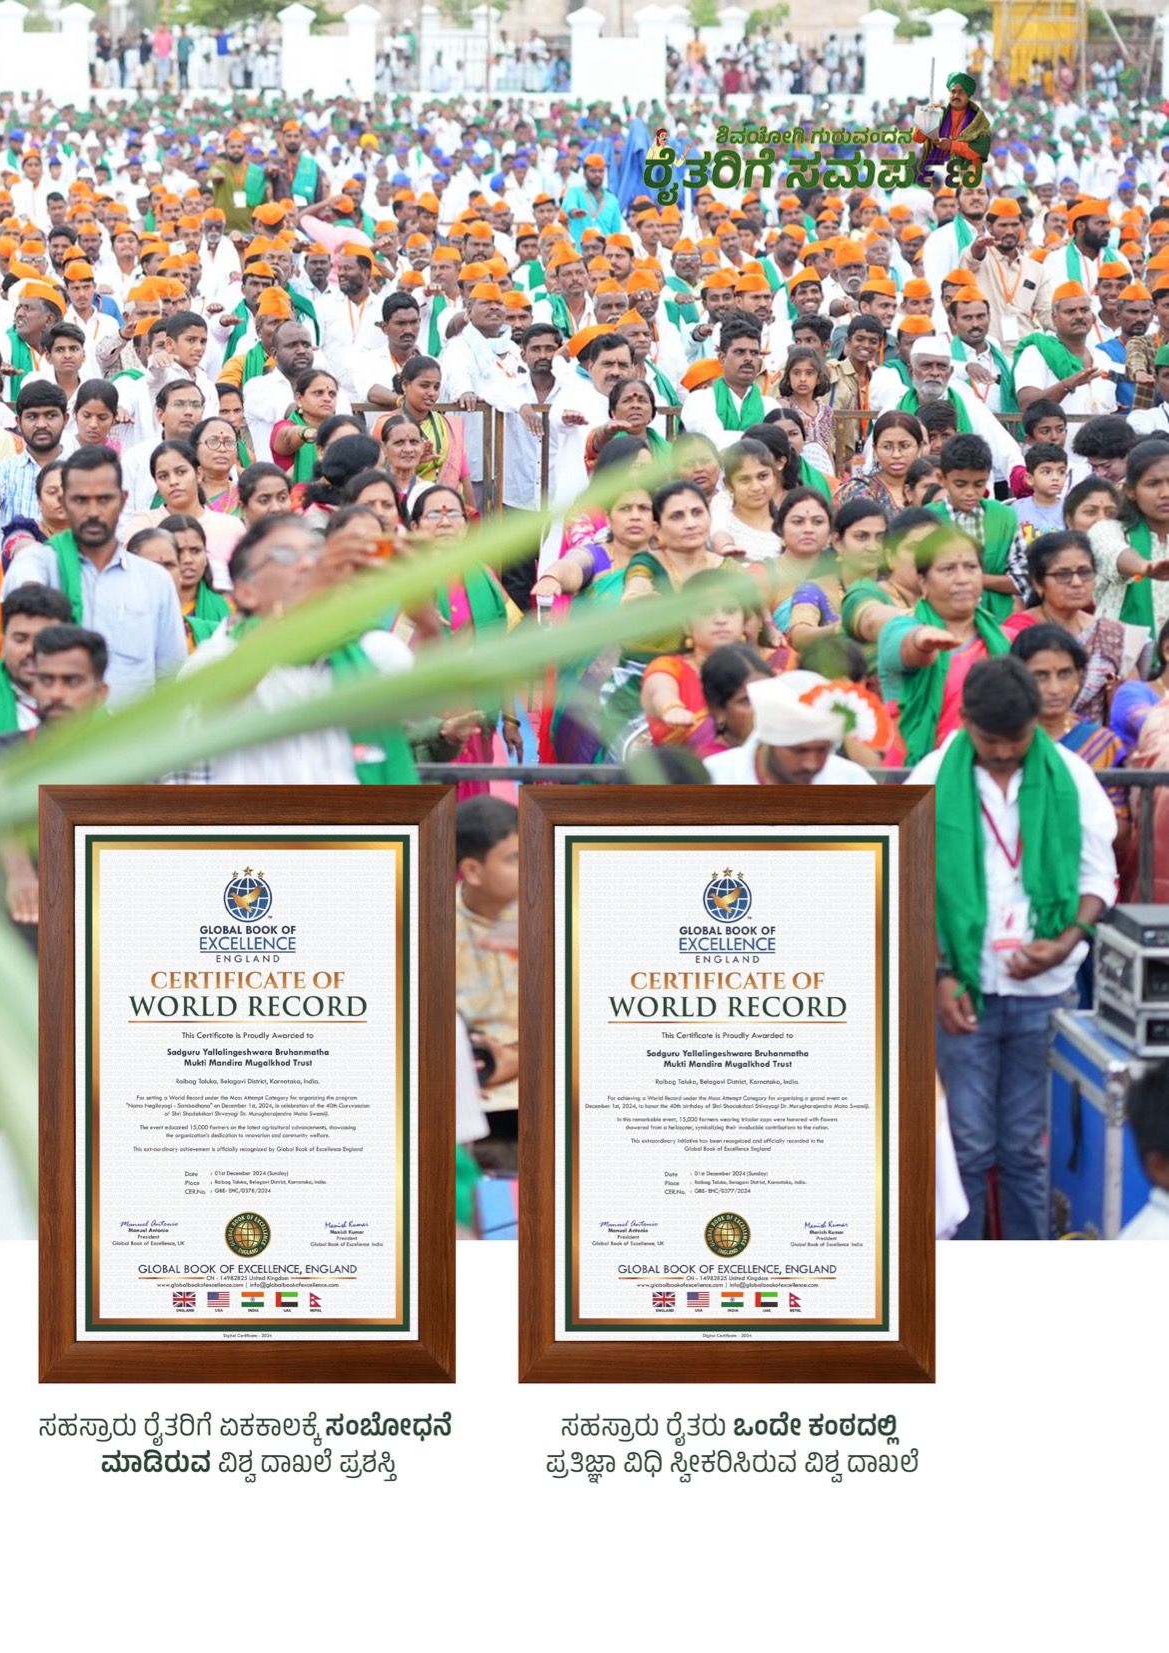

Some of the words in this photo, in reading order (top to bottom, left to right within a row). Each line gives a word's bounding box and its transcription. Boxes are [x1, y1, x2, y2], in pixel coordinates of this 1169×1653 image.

[199, 925, 243, 935] GLOBAL
[245, 925, 278, 935] BOOK
[281, 925, 296, 935] OF
[679, 926, 723, 936] GLOBAL
[725, 926, 757, 936] BOOK
[760, 926, 776, 936] OF
[199, 936, 296, 951] EXCELLENCE
[679, 936, 776, 952] EXCELLENCE
[216, 954, 280, 963] ENGLAND
[695, 955, 760, 964] ENGLAND
[150, 971, 306, 989] CERTIFICATE
[312, 971, 345, 989] OF
[630, 971, 786, 990] CERTIFICATE
[792, 971, 825, 990] OF
[129, 995, 238, 1017] WORLD
[248, 995, 368, 1017] RECORD
[608, 996, 717, 1018] WORLD
[728, 996, 847, 1018] RECORD
[166, 1048, 201, 1058] Sadguru
[202, 1048, 273, 1058] Yallalingeshwara
[275, 1048, 330, 1056] Bruhanmatha
[646, 1049, 680, 1059] Sadguru
[682, 1049, 753, 1059] Yallalingeshwara
[754, 1049, 809, 1057] Bruhanmatha
[184, 1058, 207, 1067] Mukti
[208, 1058, 243, 1067] Mandira
[244, 1058, 291, 1069] Mugalkhod
[292, 1058, 313, 1067] Trust
[663, 1060, 687, 1068] Mukti
[688, 1060, 723, 1068] Mandira
[724, 1060, 771, 1070] Mugalkhod
[772, 1060, 793, 1068] Trust
[138, 1264, 181, 1274] GLOBAL
[184, 1264, 216, 1274] BOOK
[219, 1264, 235, 1274] OF
[238, 1264, 303, 1276] EXCELLENCE,
[305, 1264, 358, 1274] ENGLAND
[618, 1264, 660, 1274] GLOBAL
[663, 1264, 696, 1274] BOOK
[699, 1264, 715, 1274] OF
[718, 1264, 782, 1275] EXCELLENCE,
[785, 1264, 837, 1274] ENGLAND
